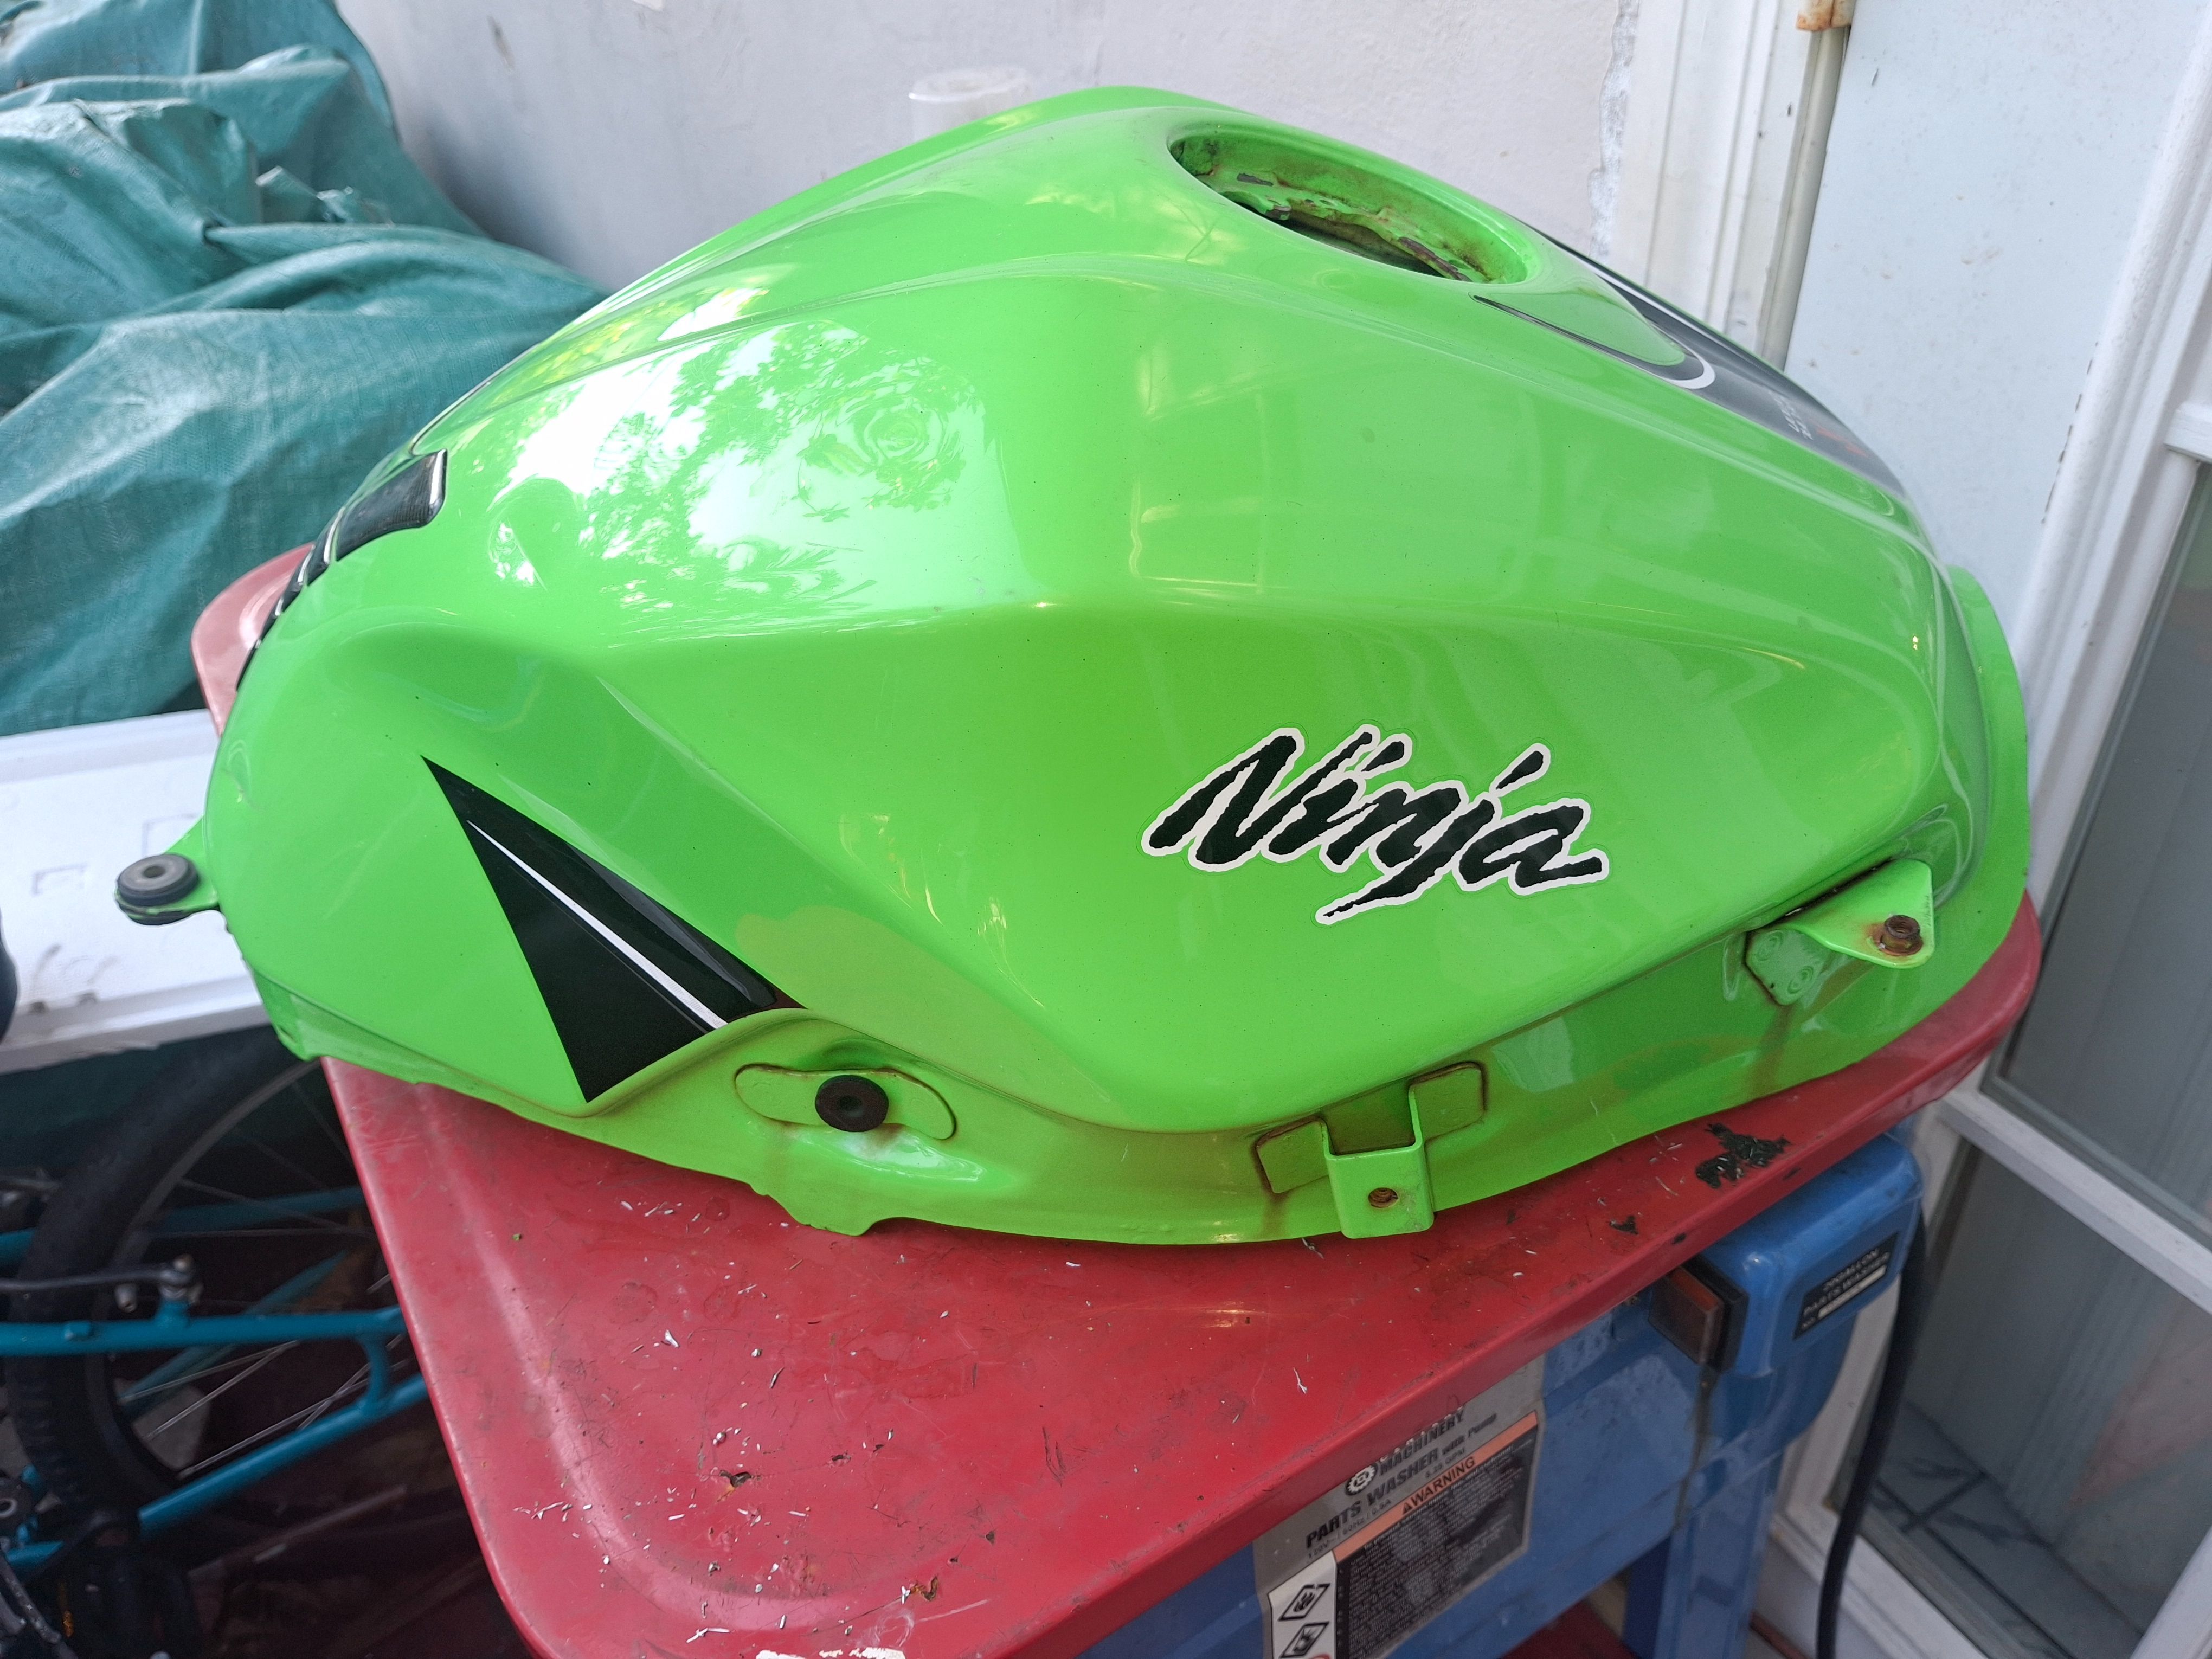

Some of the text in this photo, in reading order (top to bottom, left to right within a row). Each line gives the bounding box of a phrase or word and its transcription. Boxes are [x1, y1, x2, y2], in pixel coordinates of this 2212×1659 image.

[1142, 724, 1609, 924] Ninja
[1379, 1409, 1464, 1476] MACHINERY
[1410, 1456, 1475, 1506] WARNING
[1306, 1500, 1361, 1548] PARTS
[1367, 1447, 1438, 1506] WASHER
